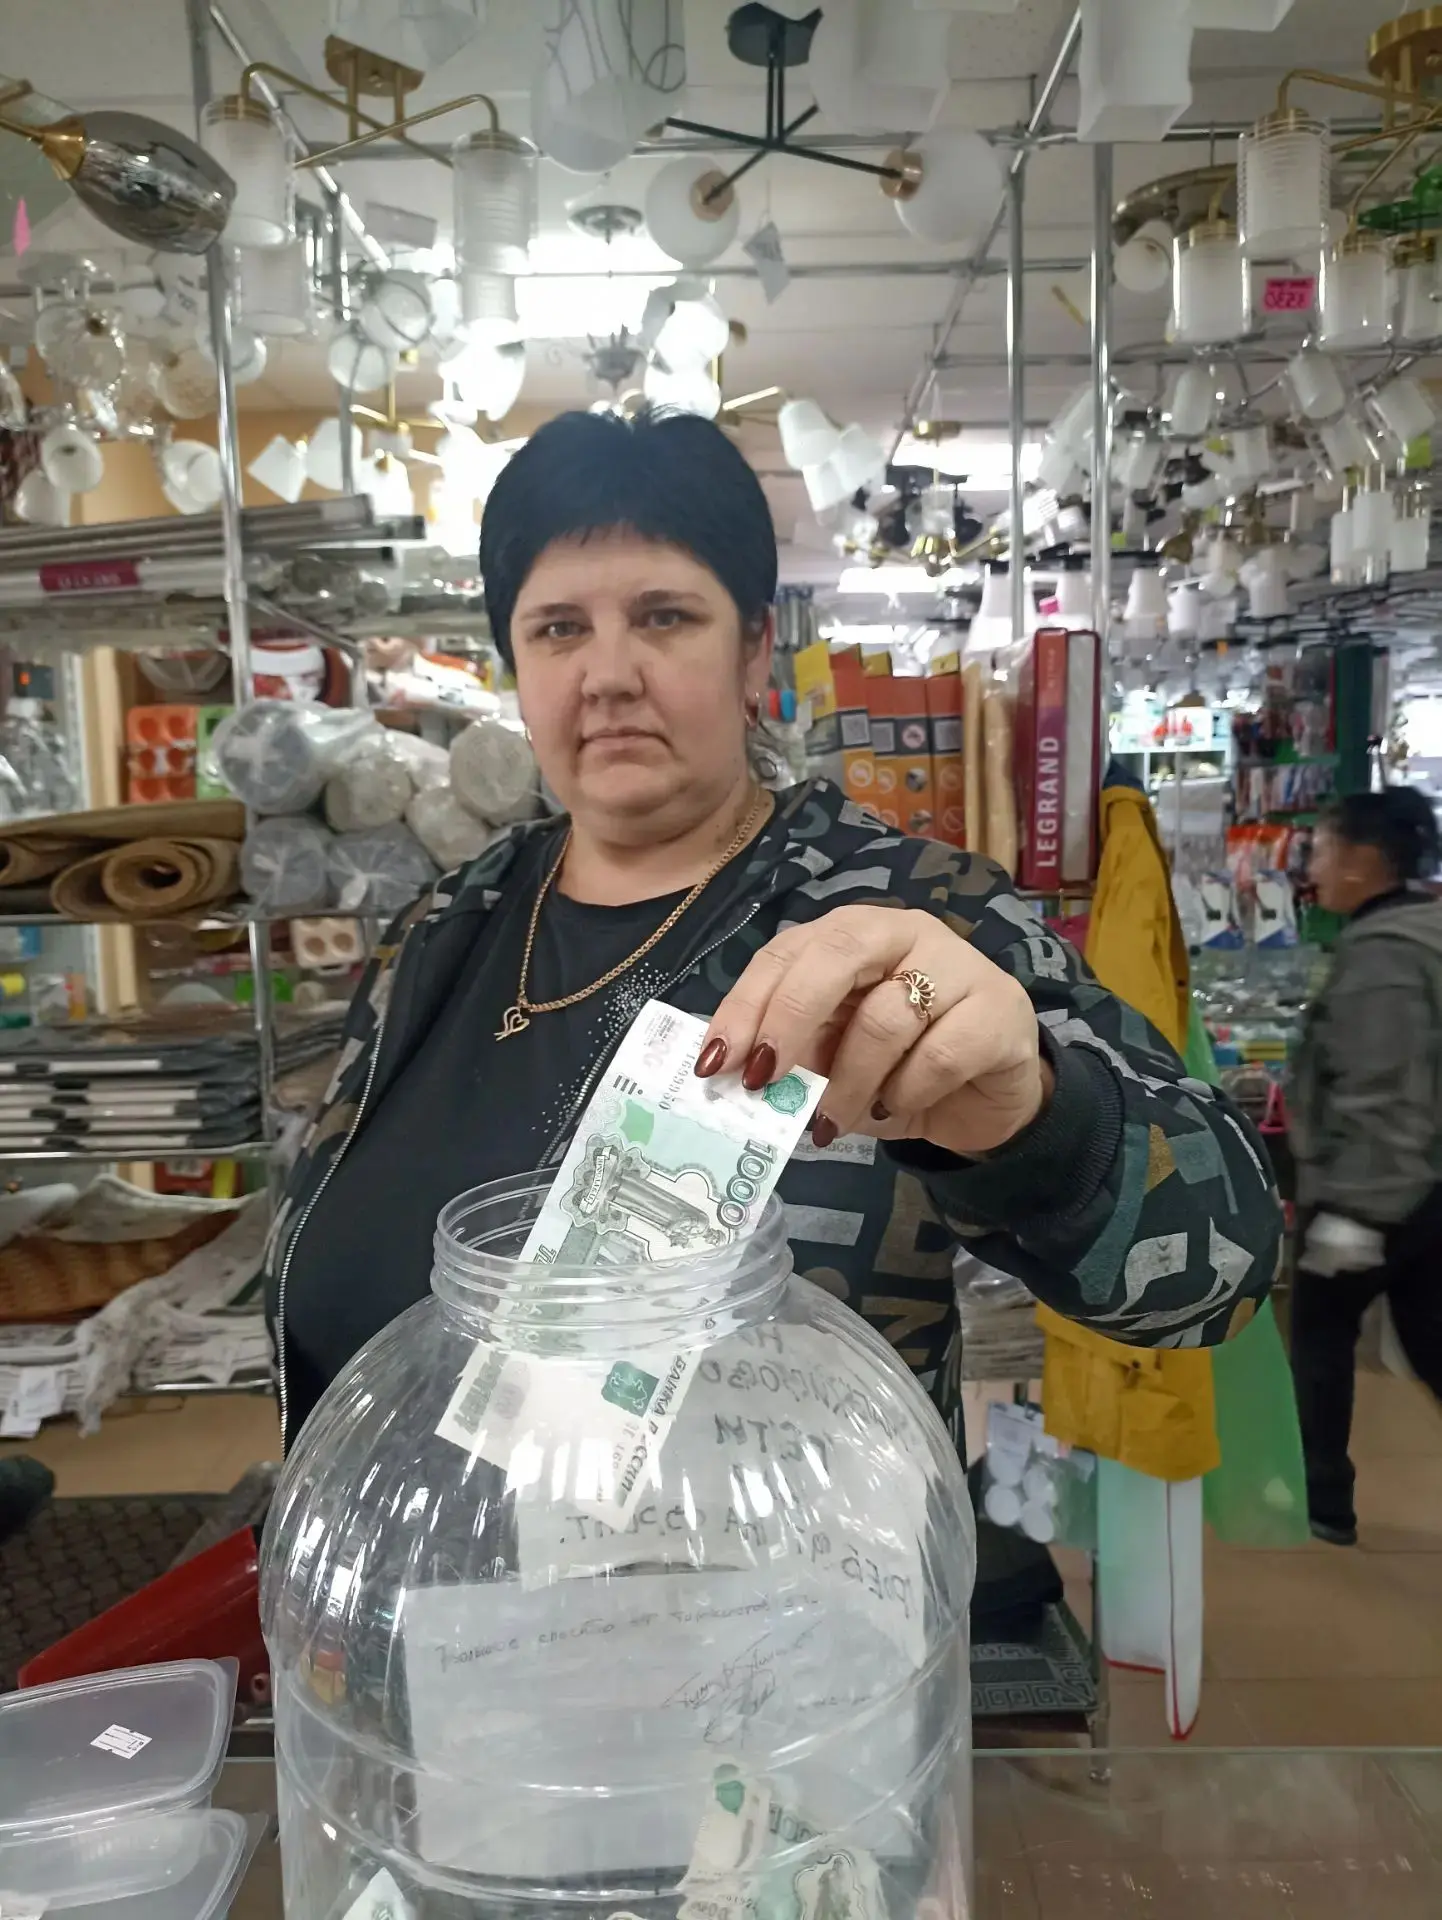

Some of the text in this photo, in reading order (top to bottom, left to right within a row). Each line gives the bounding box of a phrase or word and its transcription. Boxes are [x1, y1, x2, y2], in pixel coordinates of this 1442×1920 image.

[1037, 737, 1059, 868] LEGRAND
[716, 1138, 777, 1231] 1000
[621, 1420, 659, 1493] РССИИ
